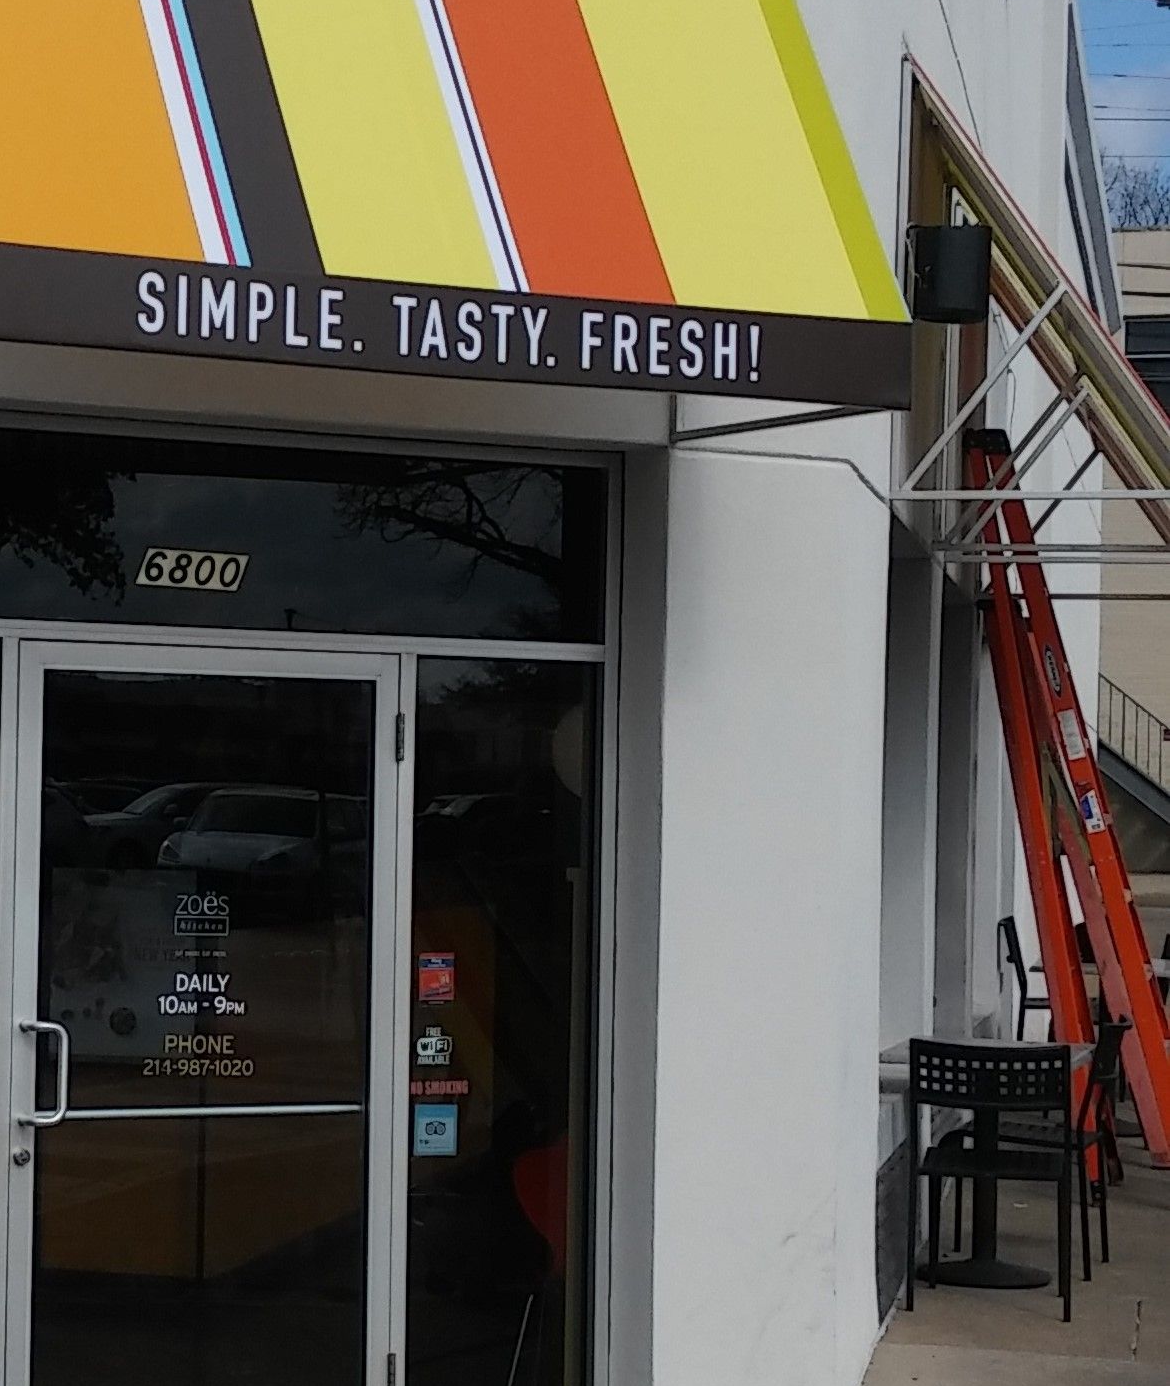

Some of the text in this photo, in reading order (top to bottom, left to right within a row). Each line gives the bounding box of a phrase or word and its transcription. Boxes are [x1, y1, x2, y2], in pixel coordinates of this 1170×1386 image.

[135, 270, 764, 383] SIMPLE. TASTY. FRESH!
[144, 551, 241, 587] 6800
[176, 973, 230, 993] DAILY
[425, 1026, 442, 1036] FREE
[164, 1034, 235, 1055] PHONE
[142, 1059, 255, 1076] 214-987-1020
[424, 1080, 469, 1095] SMOKING
